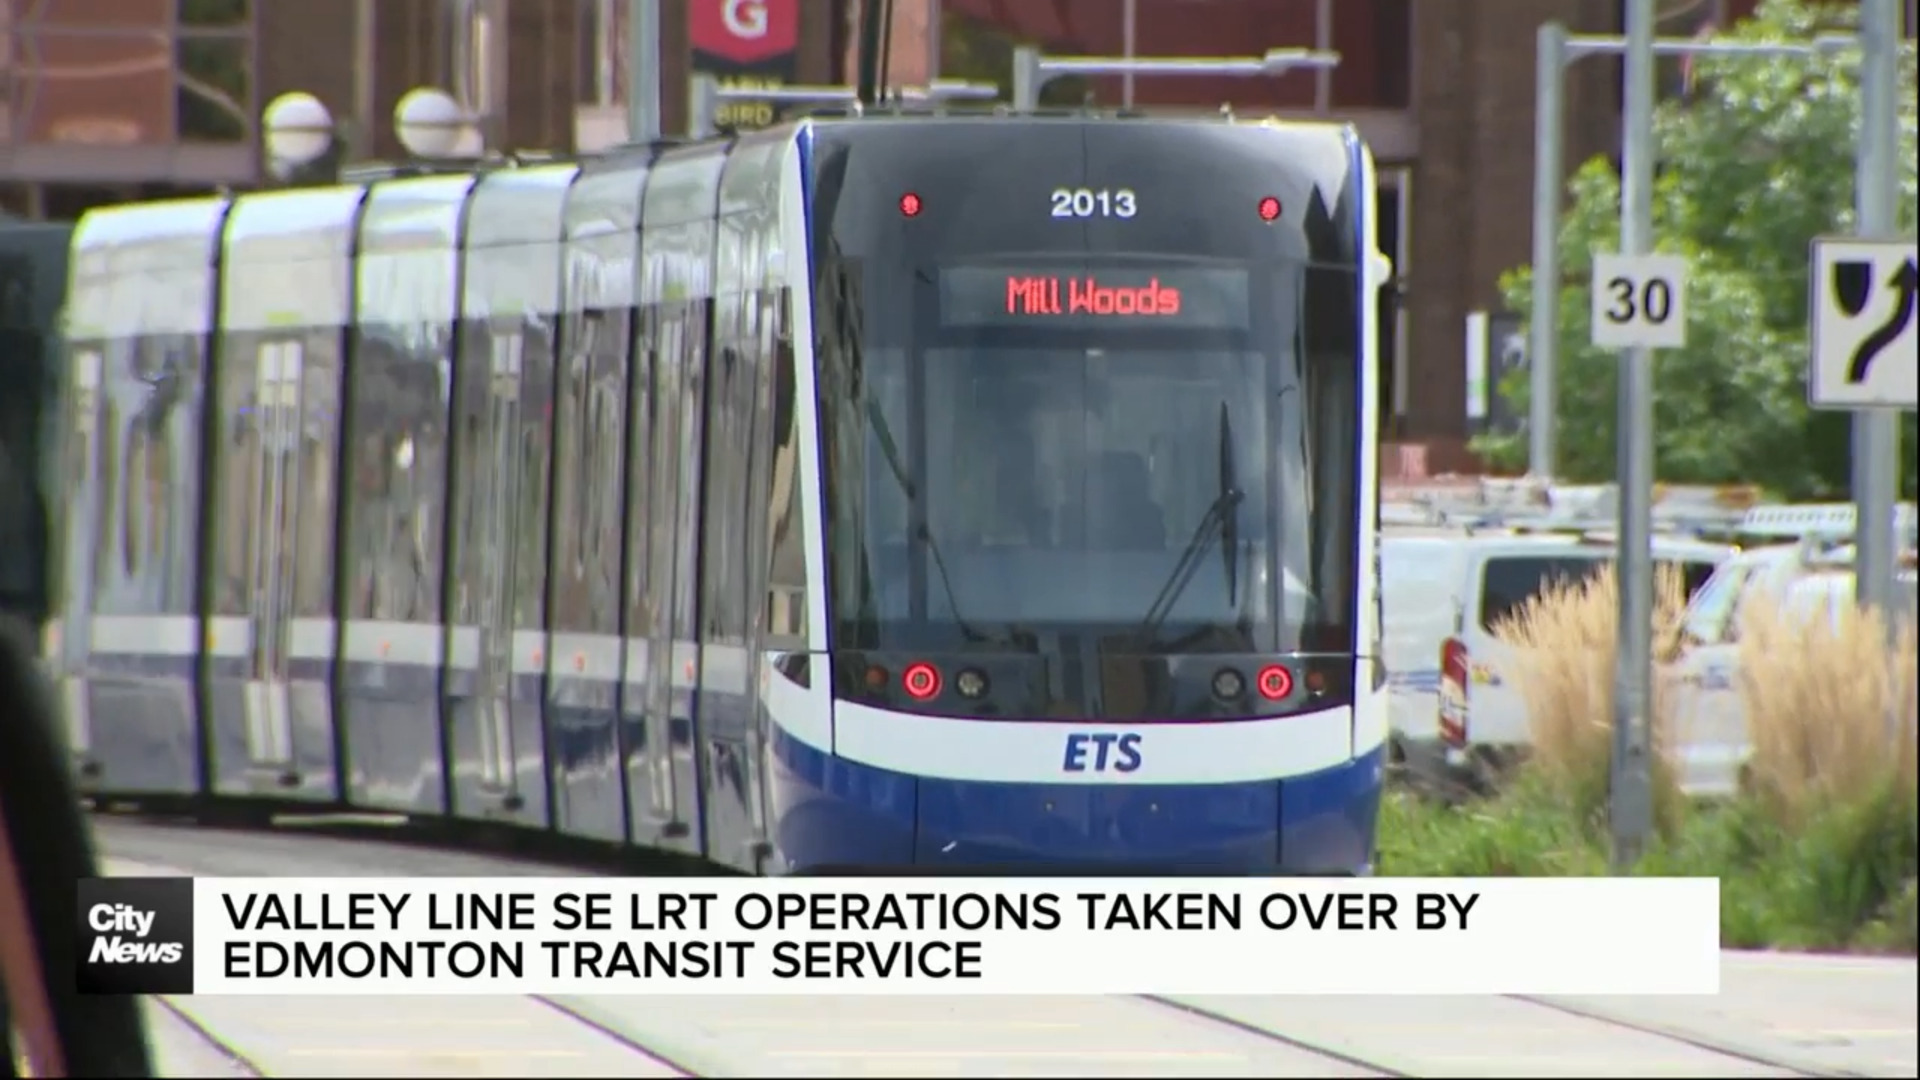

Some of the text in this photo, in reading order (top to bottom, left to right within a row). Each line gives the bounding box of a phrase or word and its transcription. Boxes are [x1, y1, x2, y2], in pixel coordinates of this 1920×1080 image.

[722, 0, 768, 39] G
[1051, 188, 1137, 218] 2013
[1007, 276, 1180, 315] Mill Woods
[1606, 276, 1671, 325] 30
[1062, 732, 1143, 773] ETS
